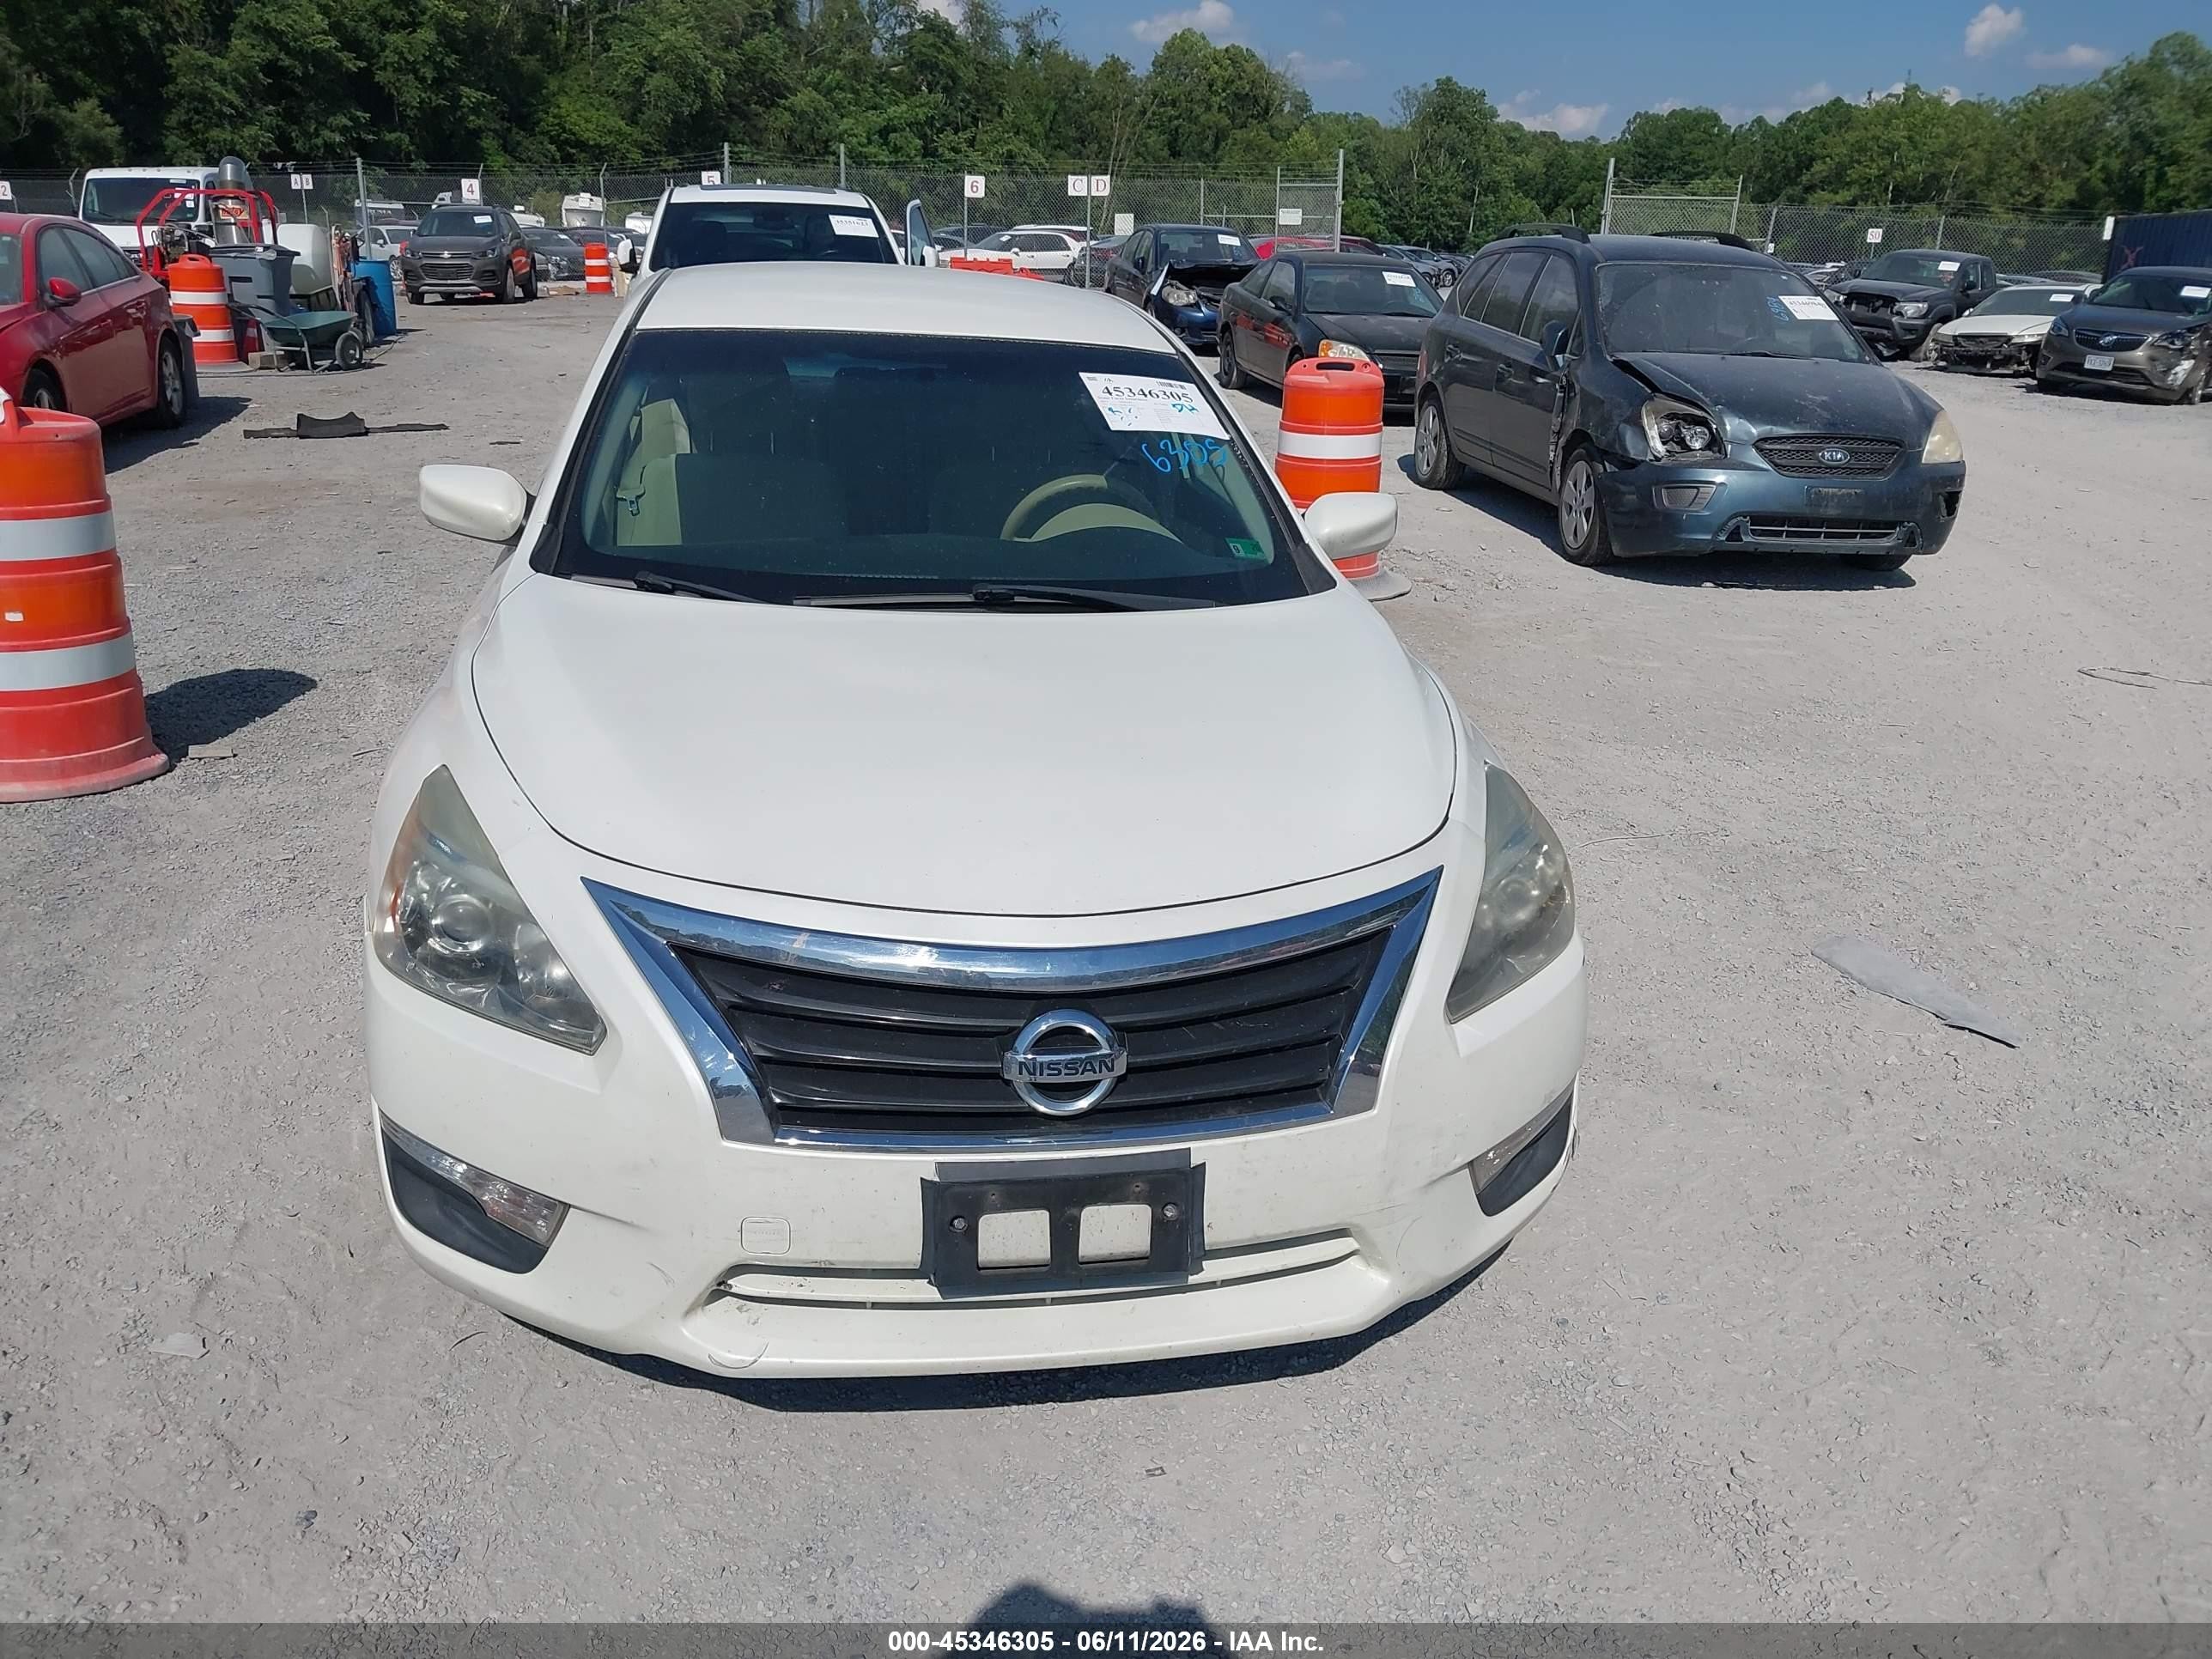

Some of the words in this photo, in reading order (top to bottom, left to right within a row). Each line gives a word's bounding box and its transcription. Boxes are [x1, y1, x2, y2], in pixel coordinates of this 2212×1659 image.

[294, 178, 299, 186] A
[970, 180, 979, 193] 6
[1073, 179, 1083, 192] C
[1096, 179, 1107, 191] D
[1, 185, 7, 196] 2
[467, 183, 475, 195] 4
[1102, 386, 1194, 404] 45346305
[1824, 452, 1844, 460] KIA
[1018, 1058, 1115, 1076] NISSAN
